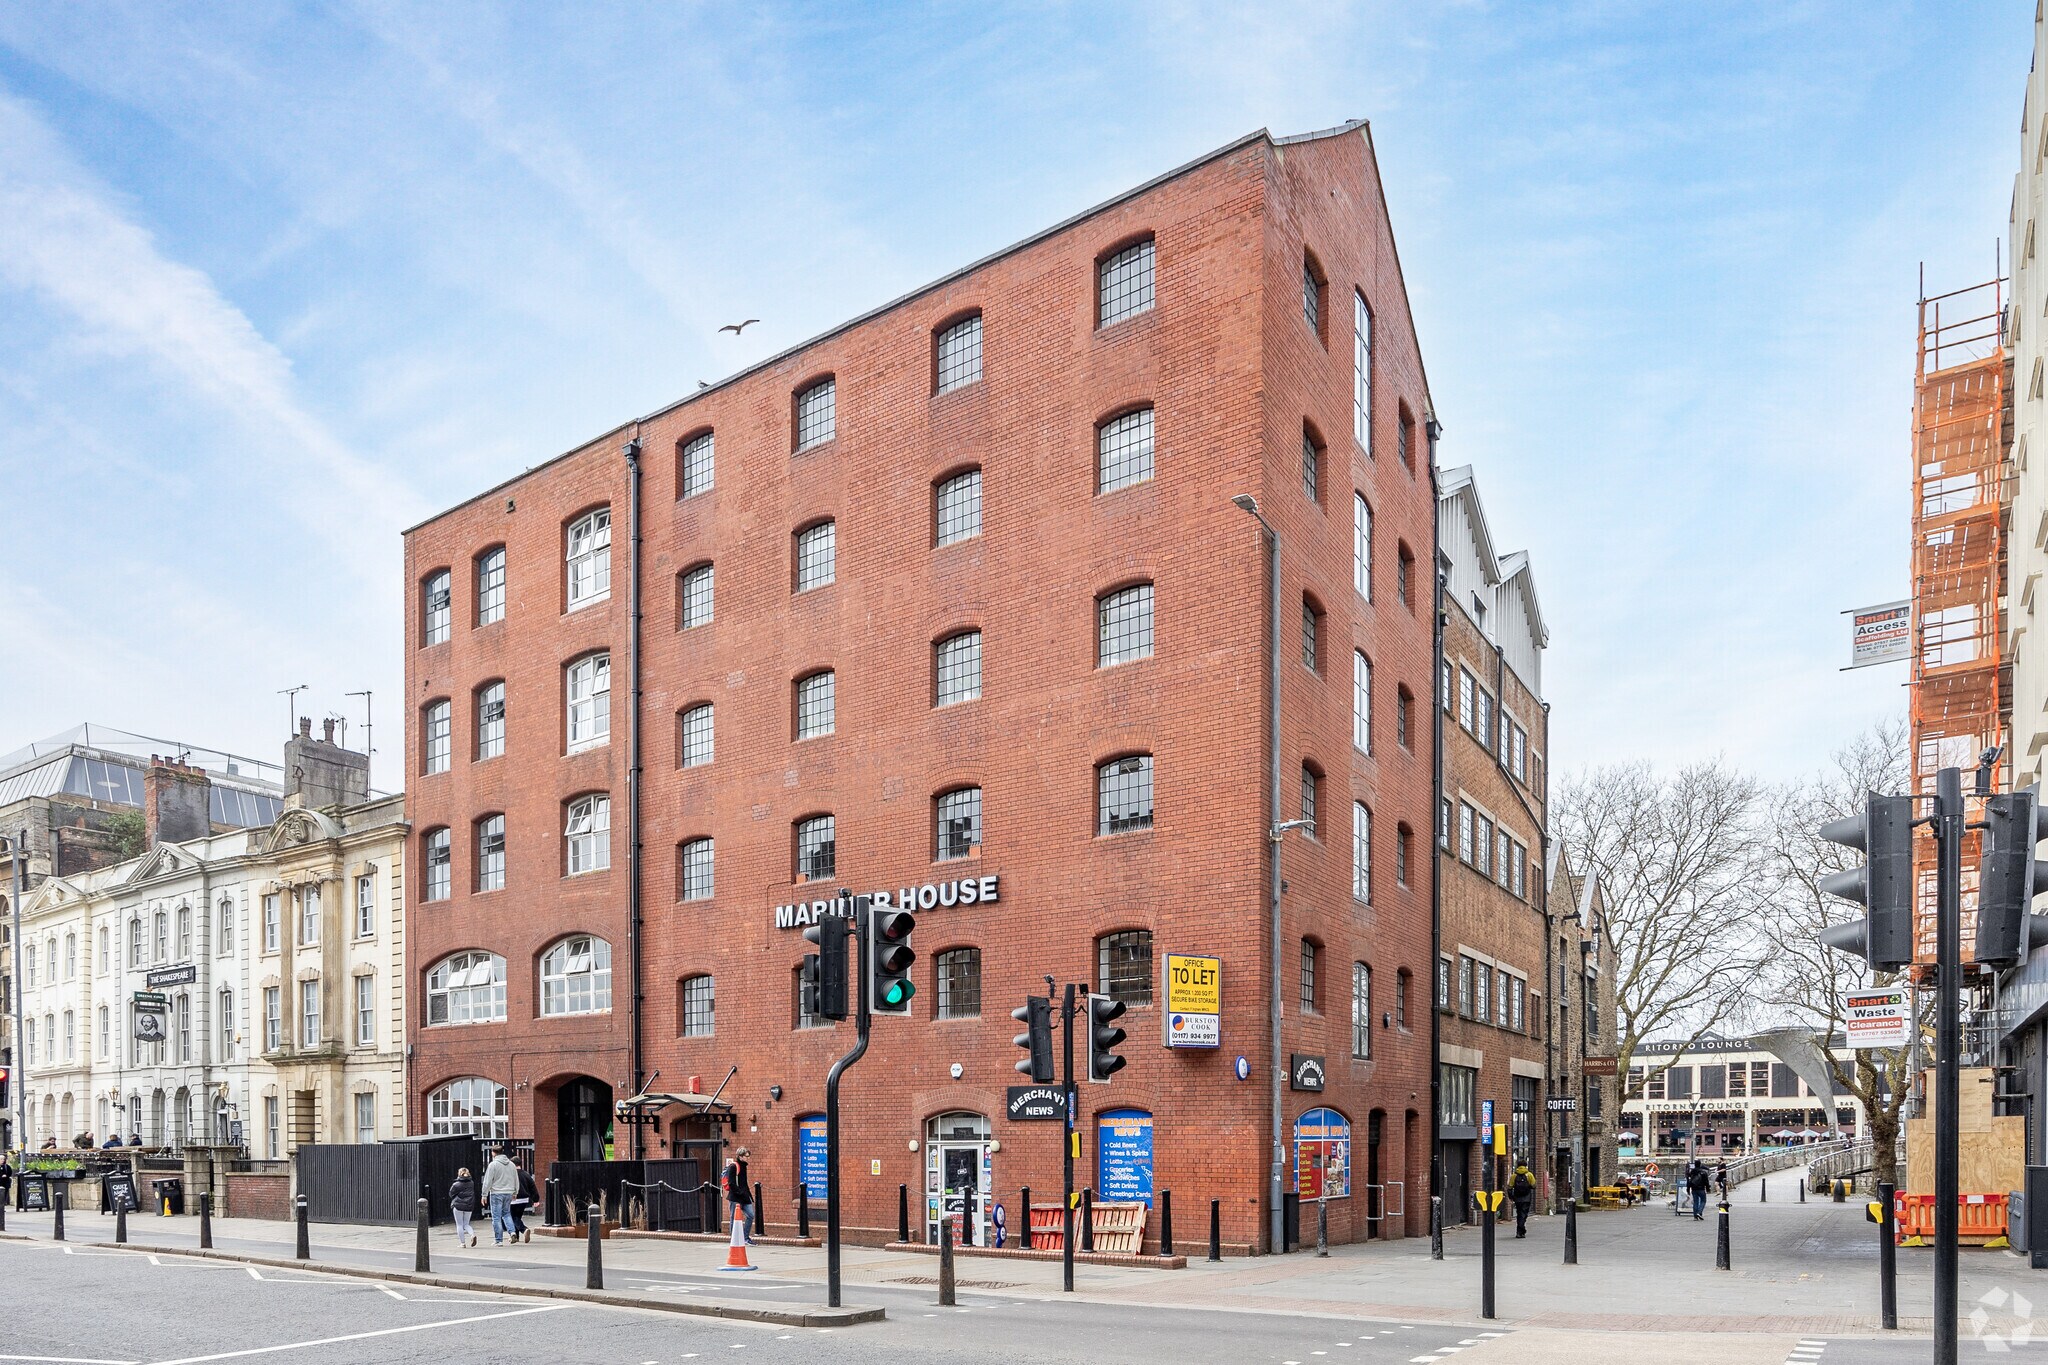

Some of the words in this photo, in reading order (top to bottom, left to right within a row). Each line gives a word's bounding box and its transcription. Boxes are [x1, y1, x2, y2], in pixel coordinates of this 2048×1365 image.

[1856, 610, 1897, 625] Smart
[1857, 620, 1907, 635] Access
[1855, 632, 1895, 643] Scaffolding
[775, 892, 891, 928] MARINR
[899, 876, 998, 911] HOUSE
[1184, 959, 1204, 967] OFFICE
[150, 975, 160, 984] THE
[160, 970, 189, 982] SHAKESPEARE
[1172, 967, 1190, 985] TO
[1192, 968, 1216, 986] LET
[1848, 996, 1889, 1007] Smart
[1854, 1008, 1896, 1018] Waste
[1849, 1020, 1901, 1029] Clearance
[1701, 1040, 1749, 1049] LOUNGE
[1547, 1100, 1576, 1110] COFFEE
[1701, 1101, 1749, 1109] OUNGE
[1026, 1106, 1054, 1116] NEWS
[810, 1129, 827, 1137] NEW
